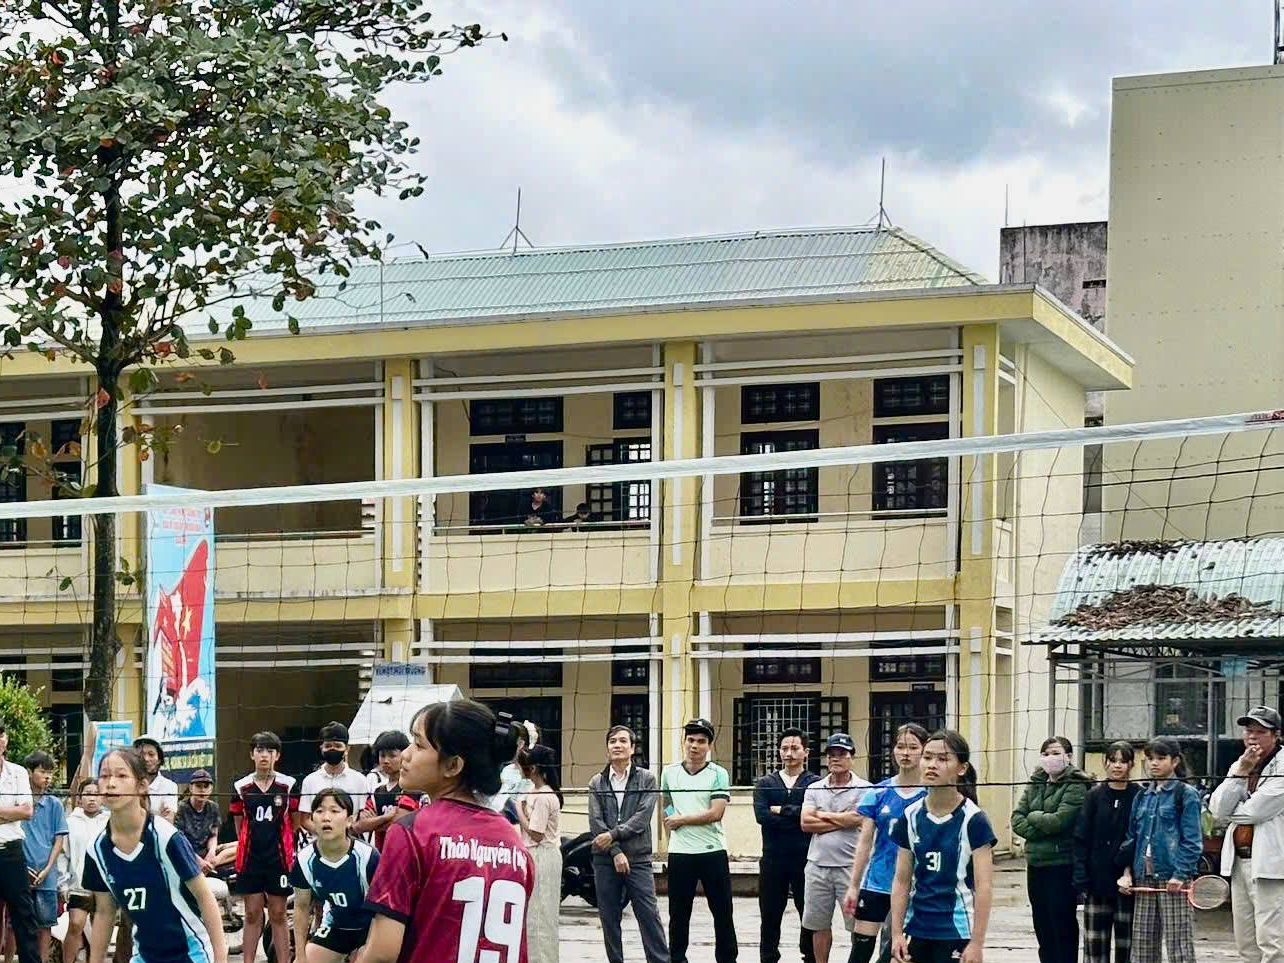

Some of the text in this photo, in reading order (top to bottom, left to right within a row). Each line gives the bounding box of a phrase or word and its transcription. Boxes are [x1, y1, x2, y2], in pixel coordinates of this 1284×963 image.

[256, 806, 274, 822] 04
[439, 834, 470, 859] Thảo
[470, 838, 512, 868] Nguyên
[124, 887, 147, 911] 27
[329, 892, 348, 908] 10
